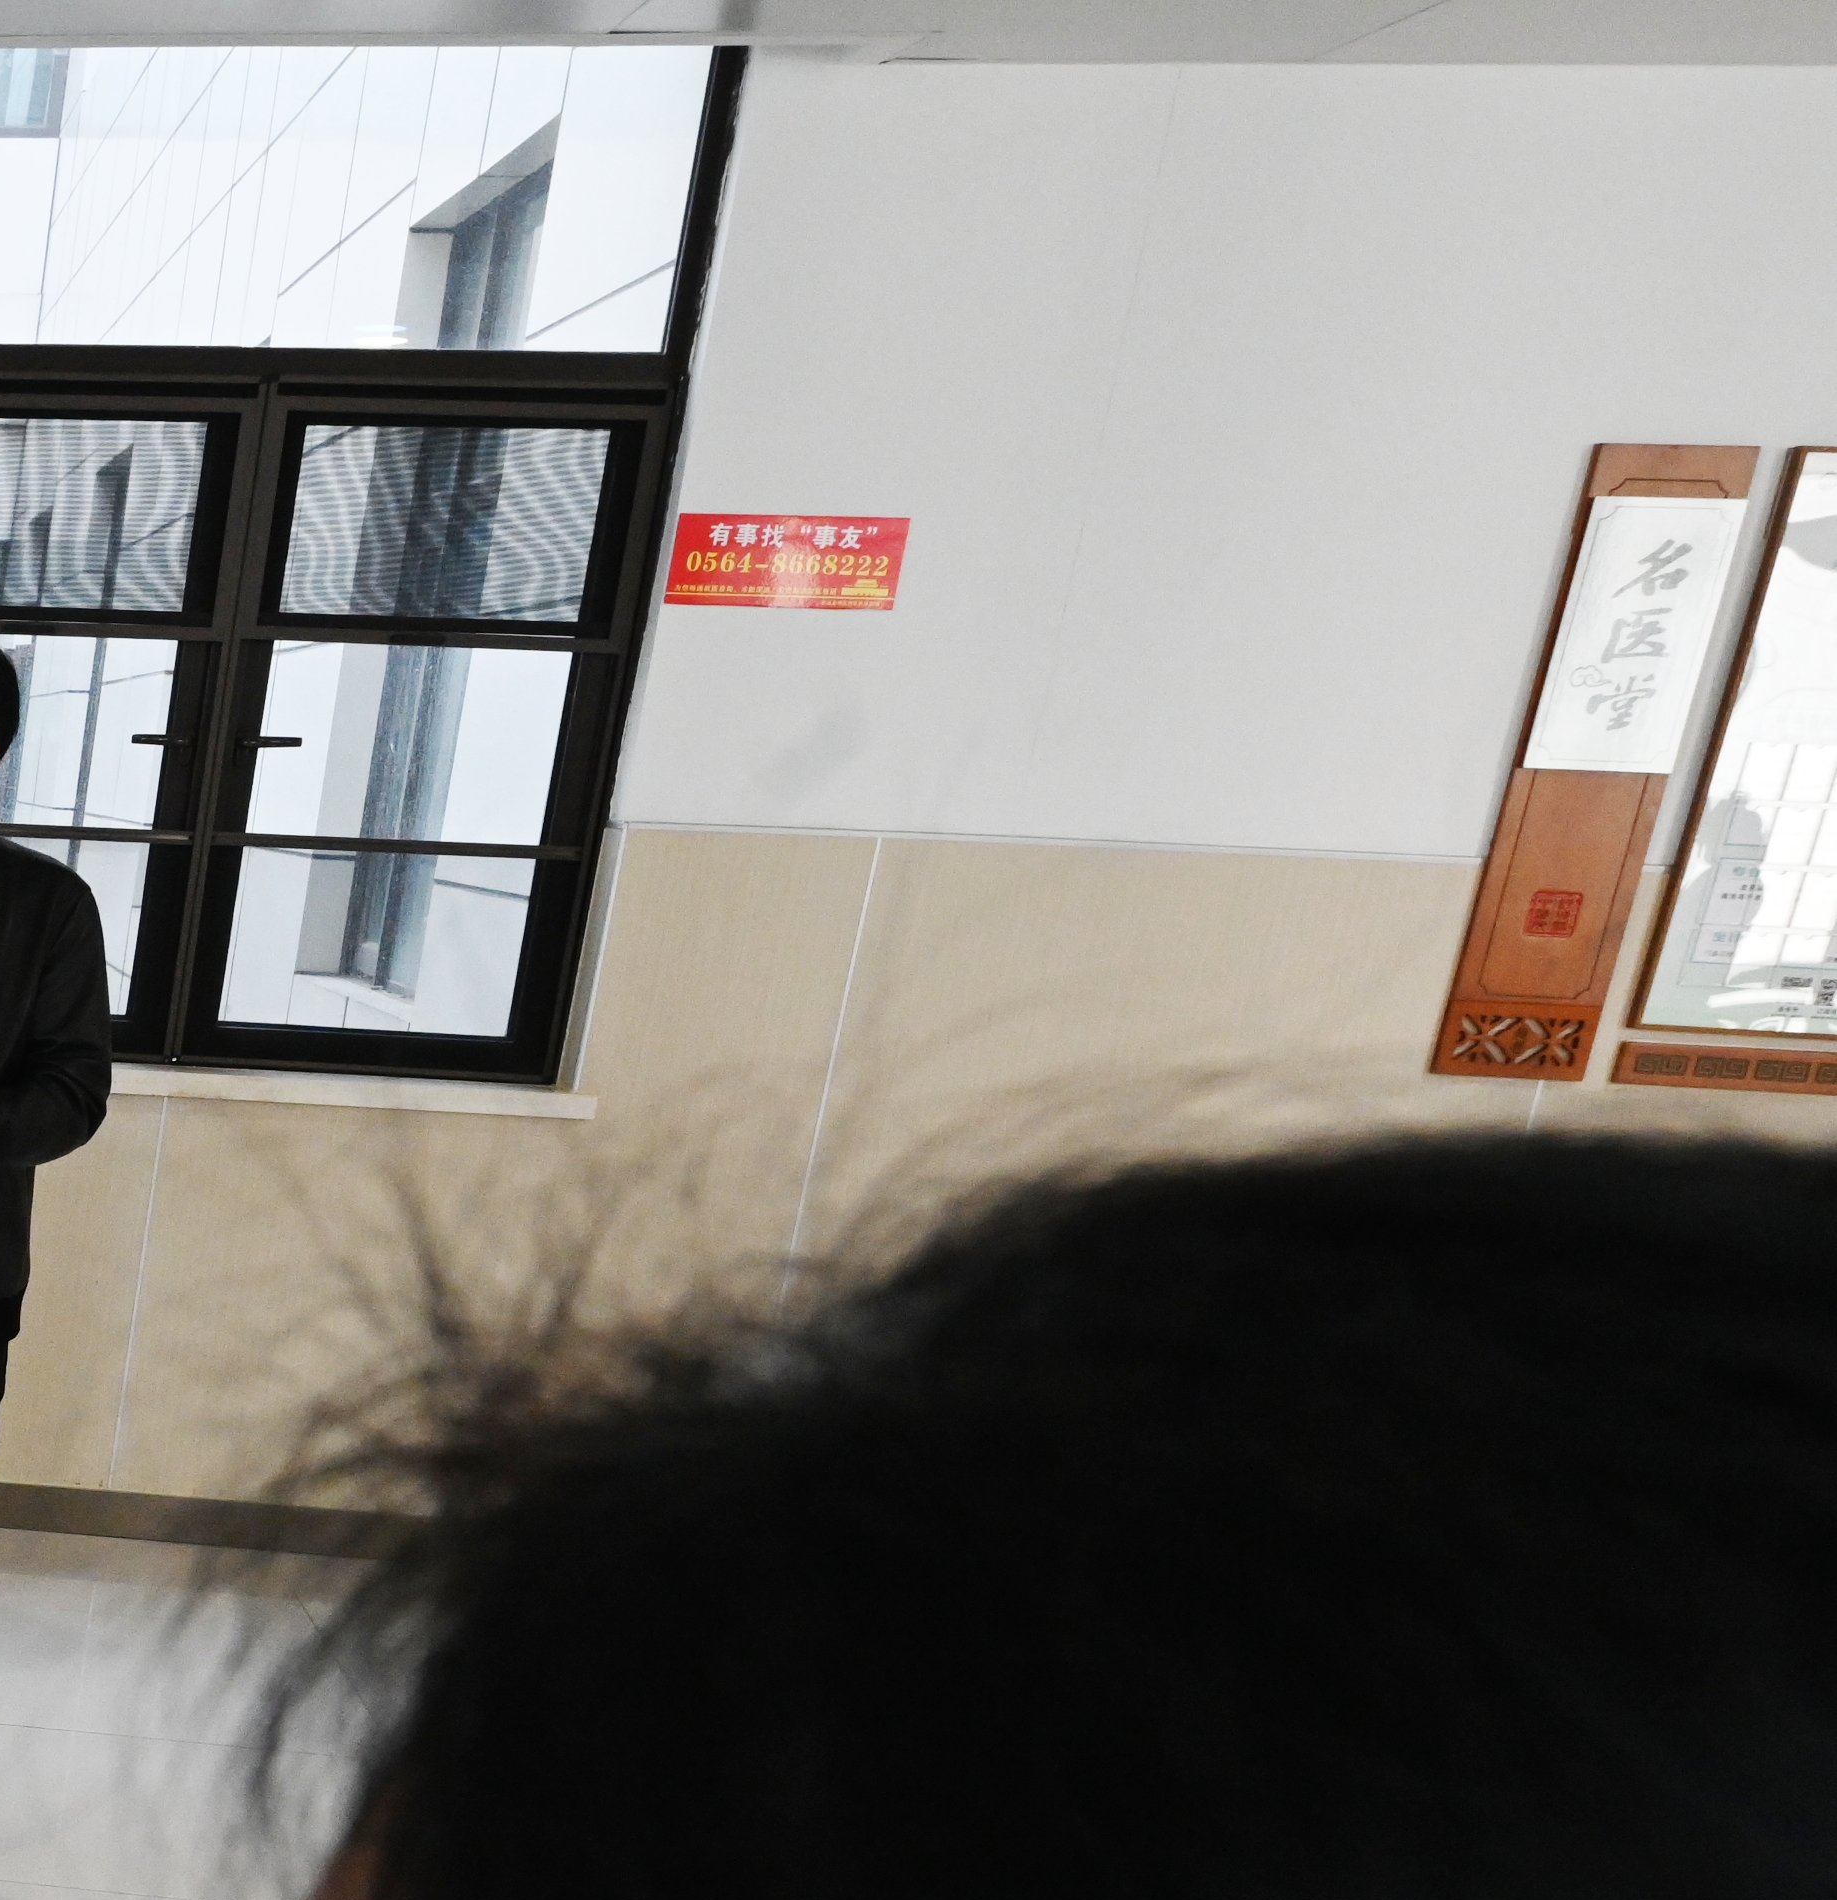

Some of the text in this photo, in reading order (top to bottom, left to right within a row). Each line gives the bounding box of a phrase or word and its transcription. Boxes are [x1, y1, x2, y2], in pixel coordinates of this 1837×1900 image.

[686, 550, 890, 577] 0564-8668222
[1586, 538, 1694, 731] 名医堂
